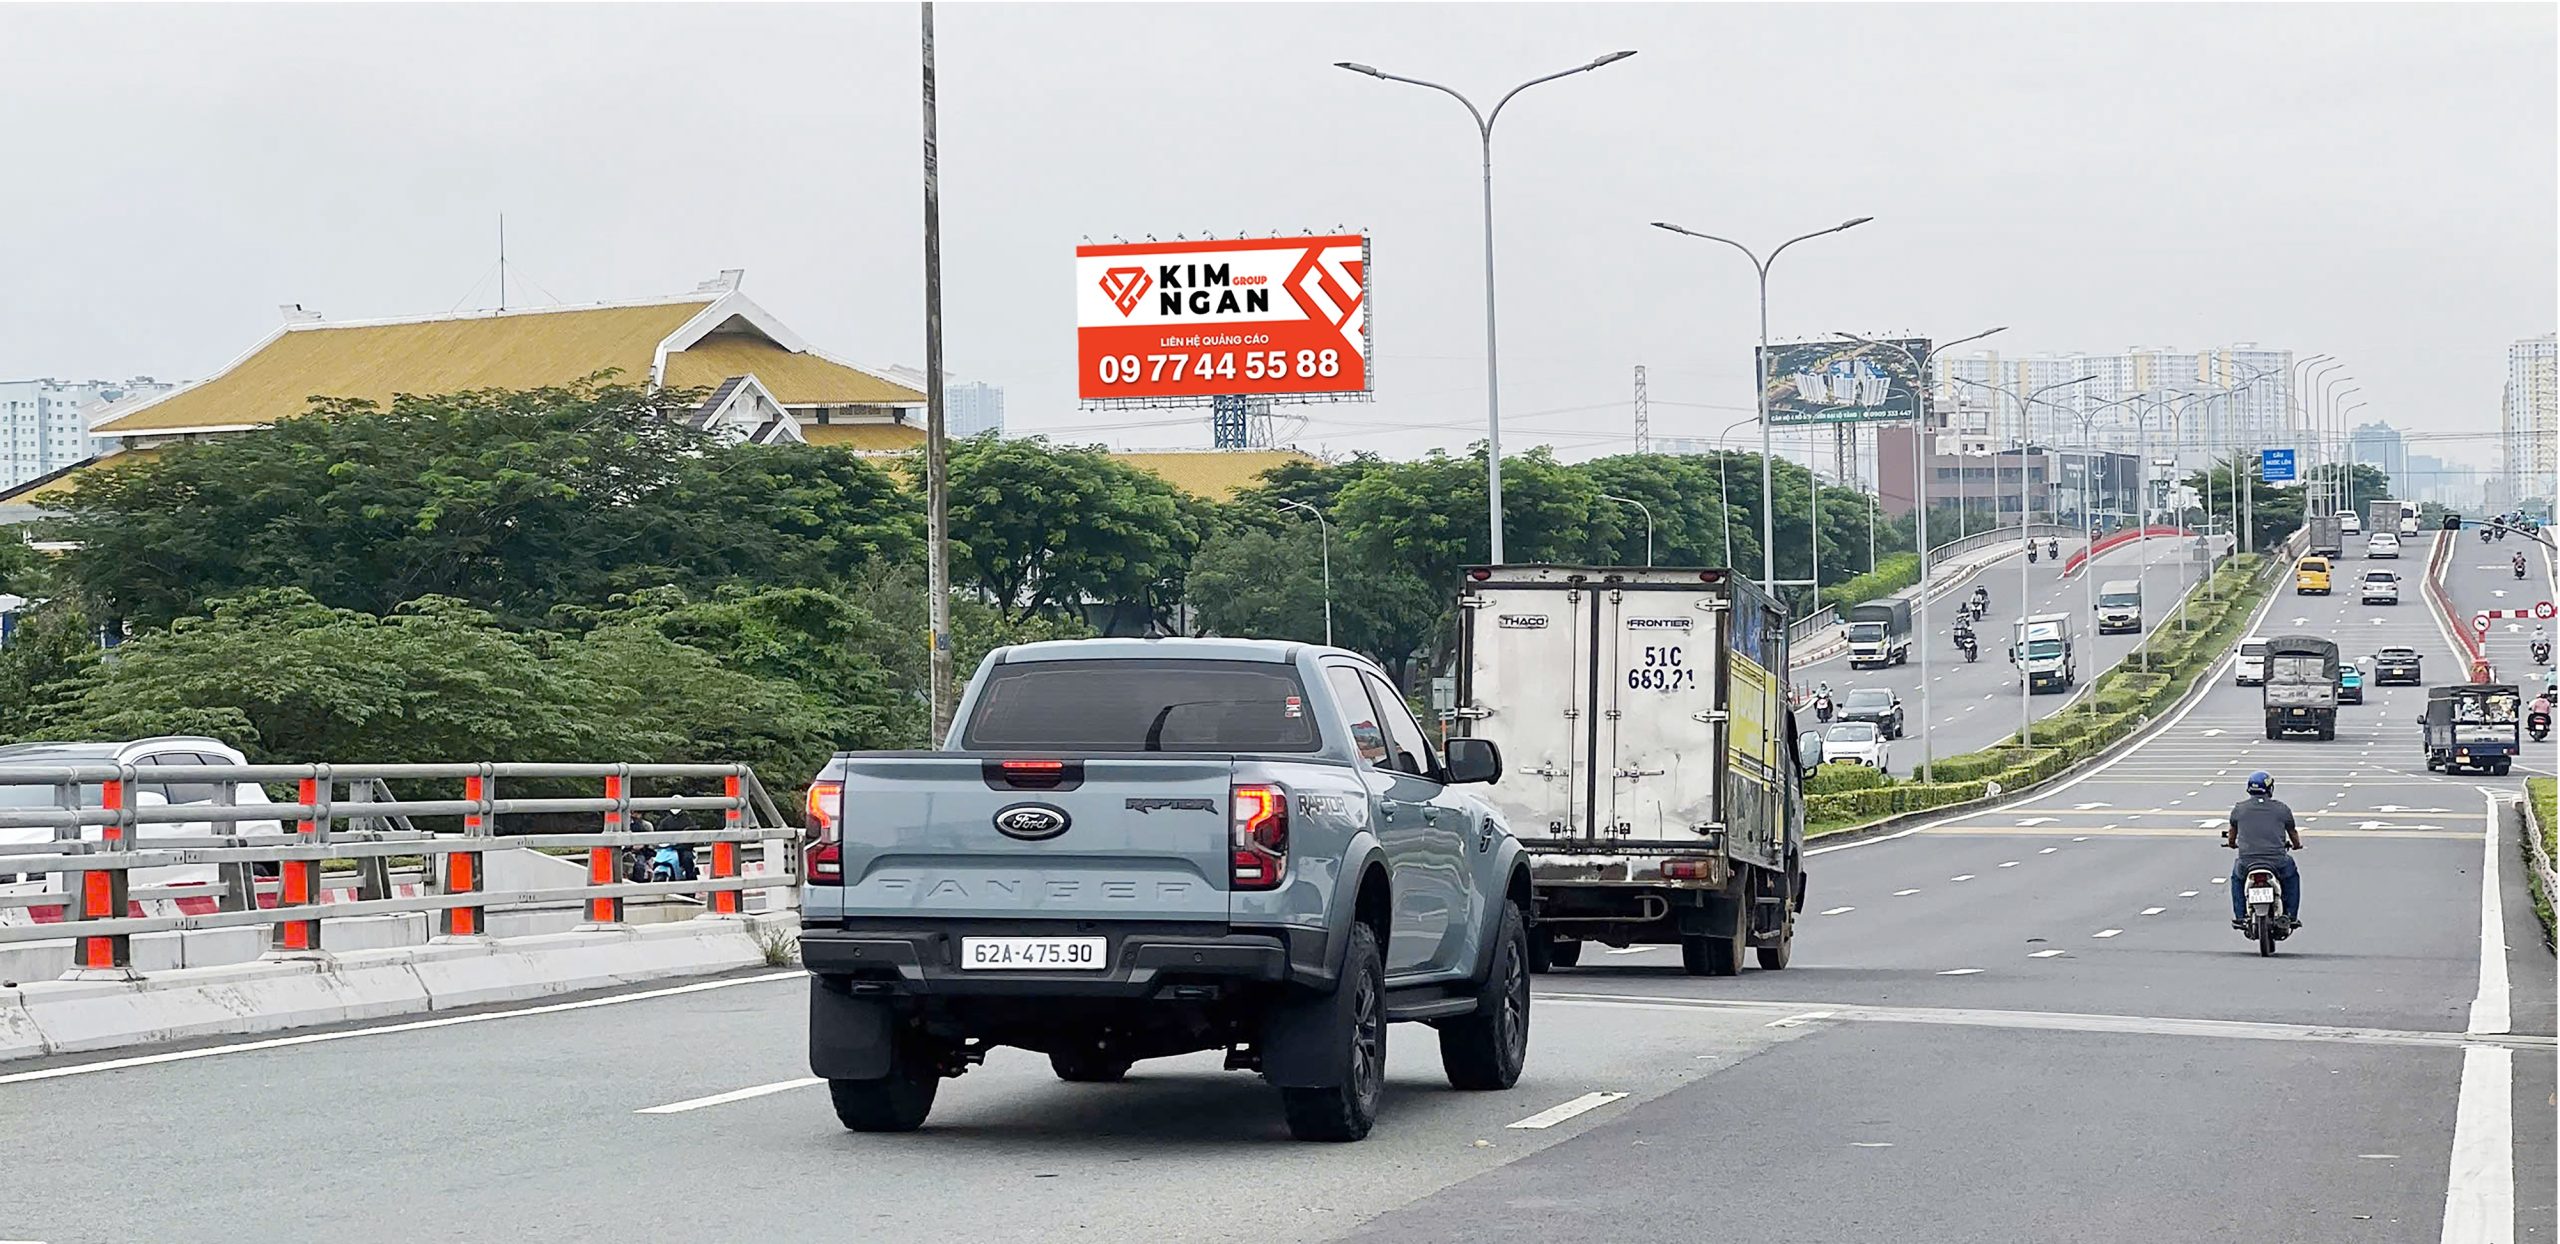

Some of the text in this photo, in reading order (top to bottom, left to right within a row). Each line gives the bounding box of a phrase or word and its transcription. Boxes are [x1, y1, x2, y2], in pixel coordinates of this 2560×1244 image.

[1160, 263, 1268, 289] KIM GROUP
[1160, 288, 1269, 316] NGAN
[1160, 333, 1269, 348] LIÊN HỆ QUẢNG CÁO
[1098, 348, 1339, 384] 09 77 44 55 88
[1503, 617, 1545, 625] THACO
[1630, 619, 1690, 627] FRONTIER
[1645, 646, 1681, 667] 51C
[1125, 798, 1219, 815] RAPTOR
[1296, 793, 1350, 823] RAPTOR
[1012, 813, 1049, 829] Ford
[975, 944, 1093, 963] 62A-475.90
